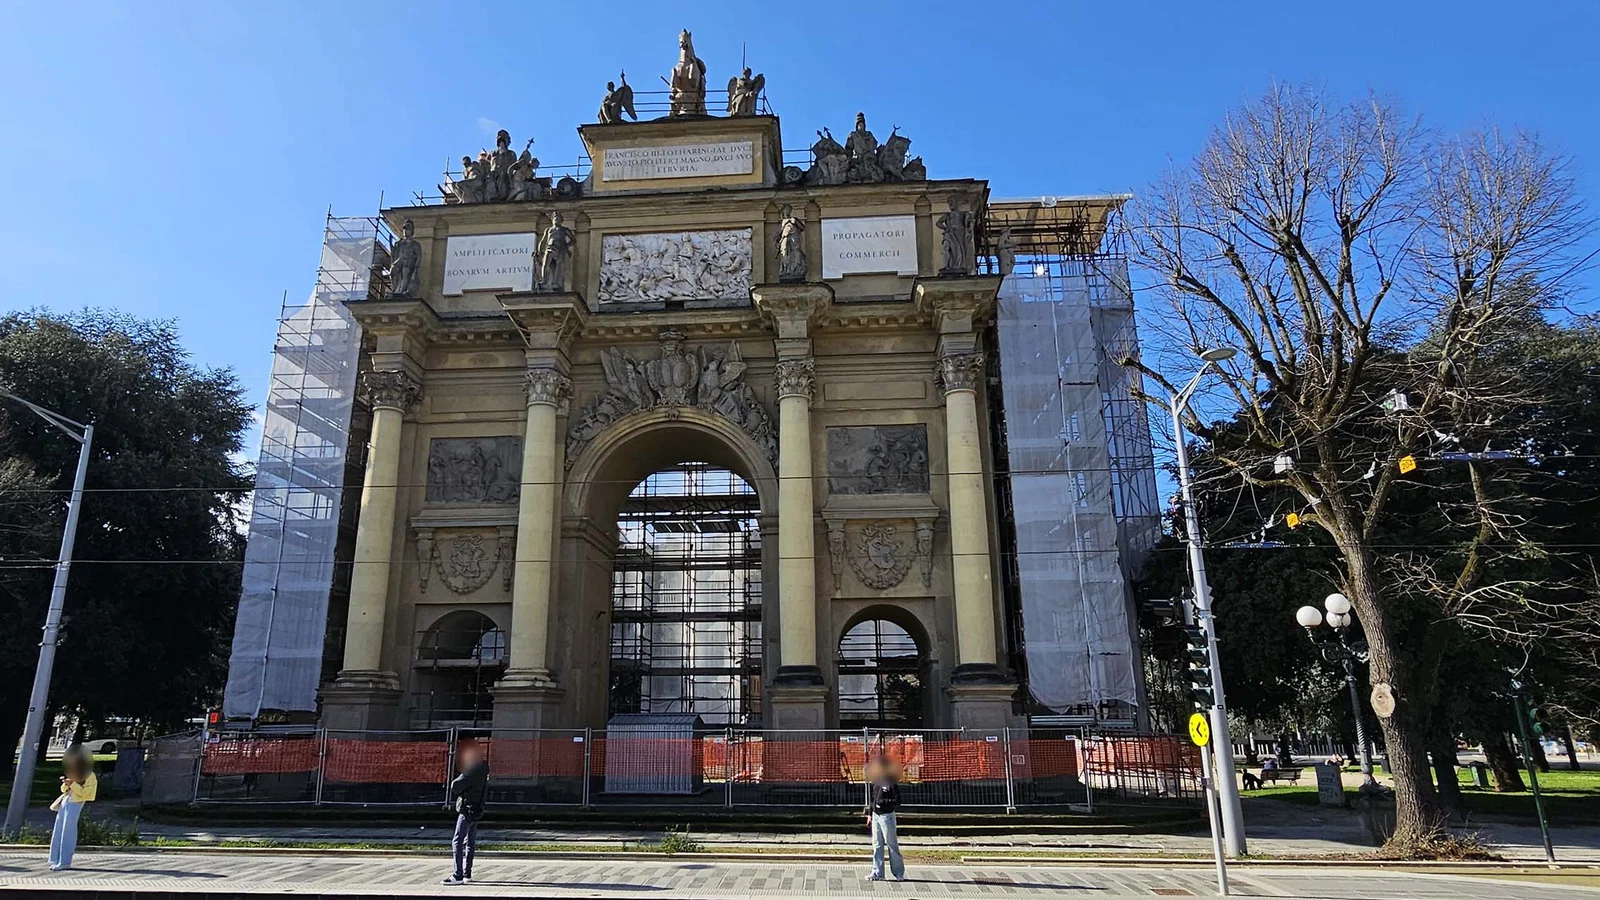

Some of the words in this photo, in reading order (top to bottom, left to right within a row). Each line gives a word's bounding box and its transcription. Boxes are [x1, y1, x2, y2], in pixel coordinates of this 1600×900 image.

[730, 145, 752, 153] DVCI
[833, 230, 905, 240] PROPAGATORI
[452, 247, 529, 258] AMPLIFICATORI
[839, 250, 901, 260] COMMERCII
[496, 266, 530, 274] ARTIVM
